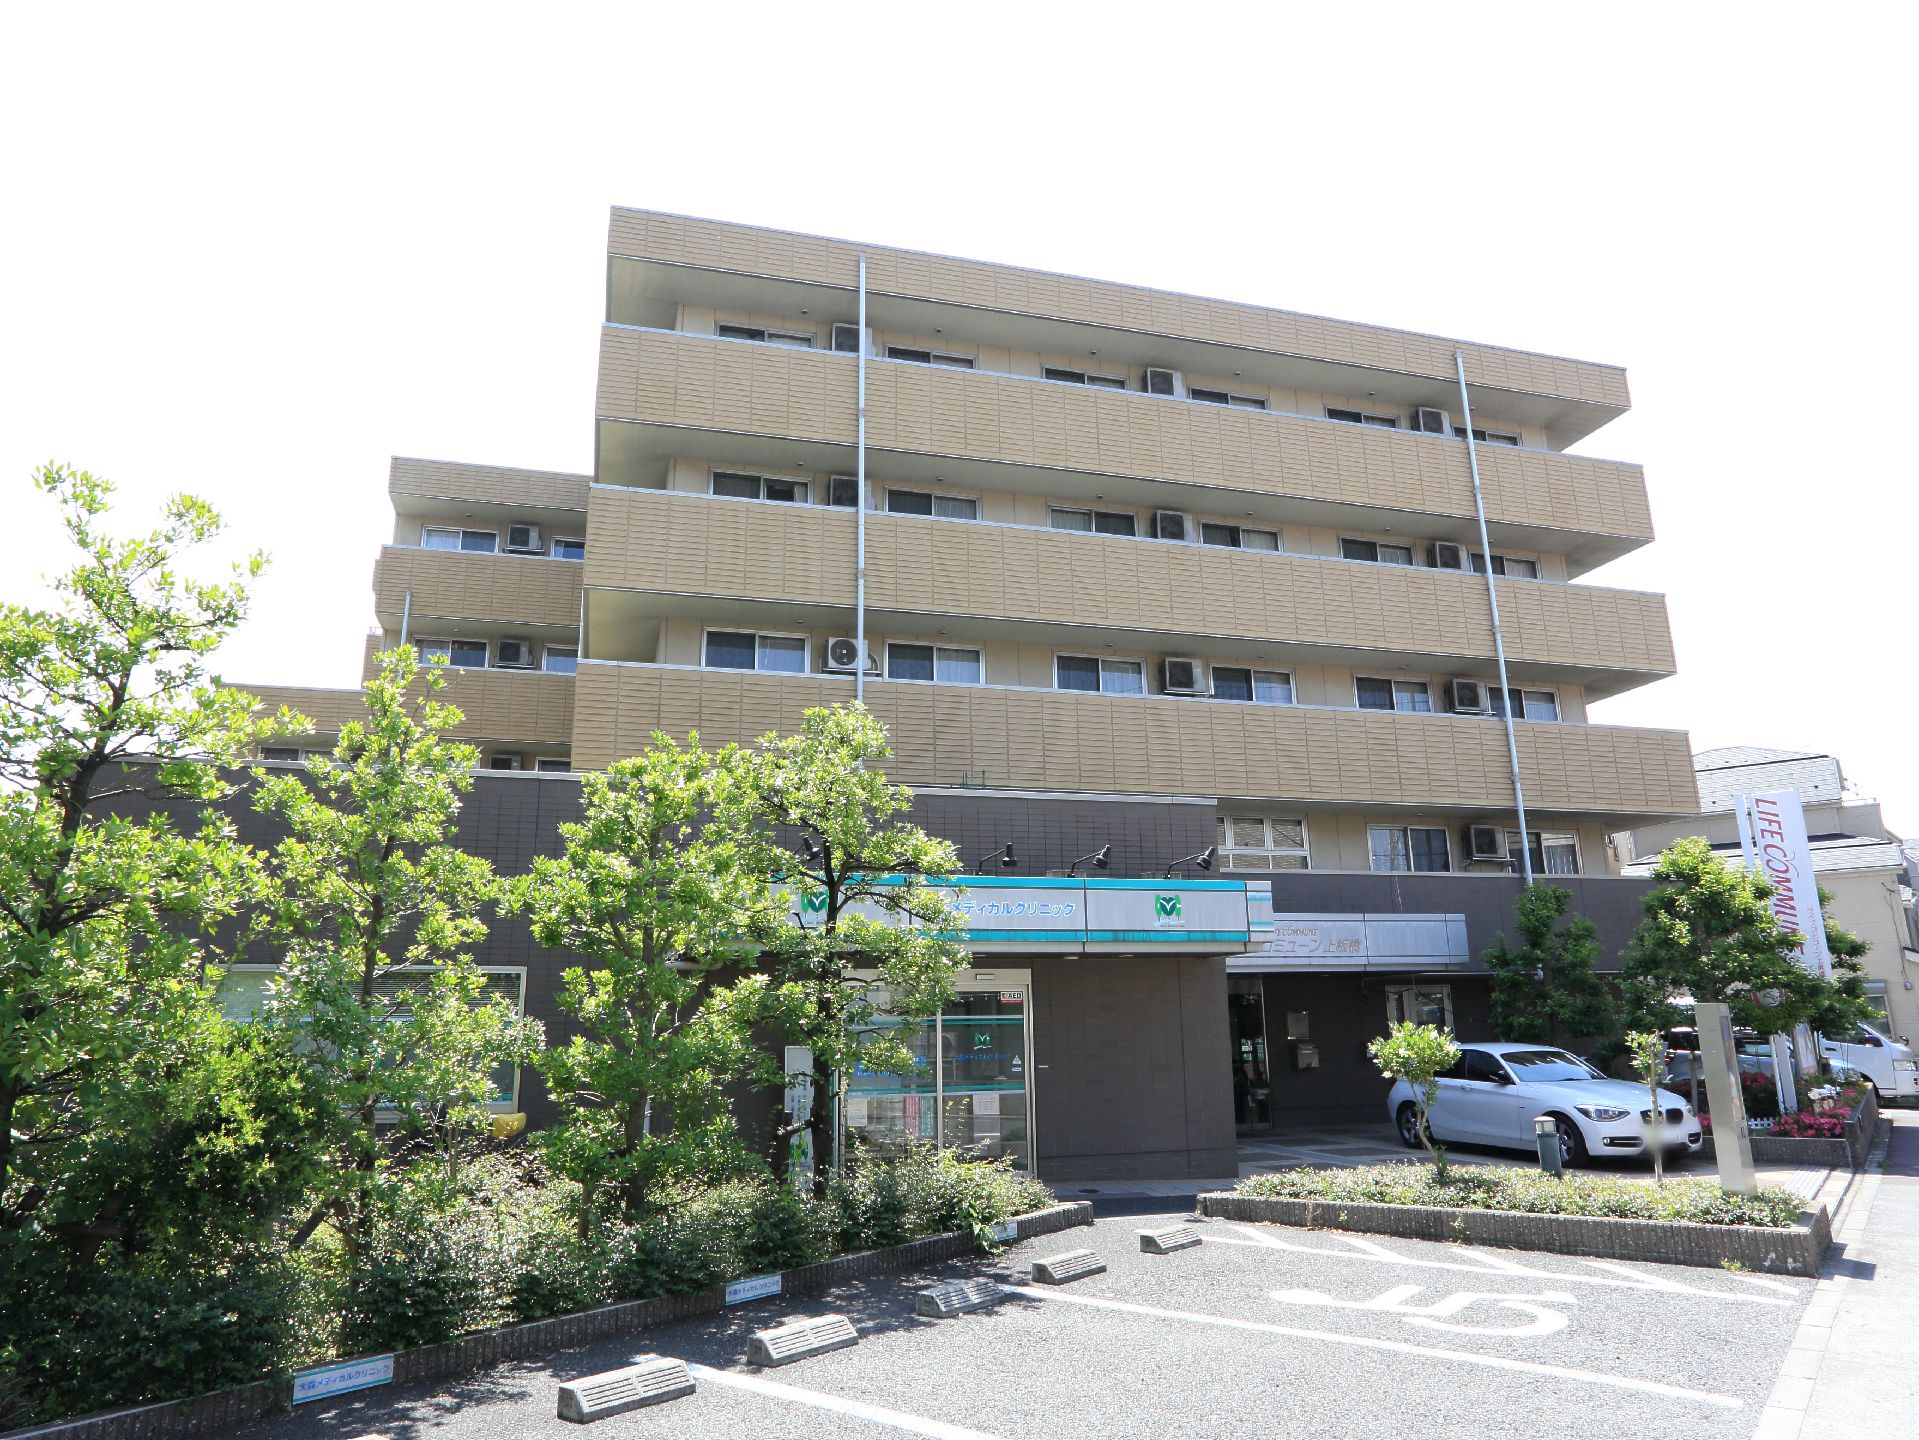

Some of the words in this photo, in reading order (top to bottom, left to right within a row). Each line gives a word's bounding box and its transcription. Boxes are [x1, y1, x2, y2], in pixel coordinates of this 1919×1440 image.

[947, 900, 1076, 917] メディカルクリニック
[298, 1364, 390, 1392] 大森メディカルクリニック
